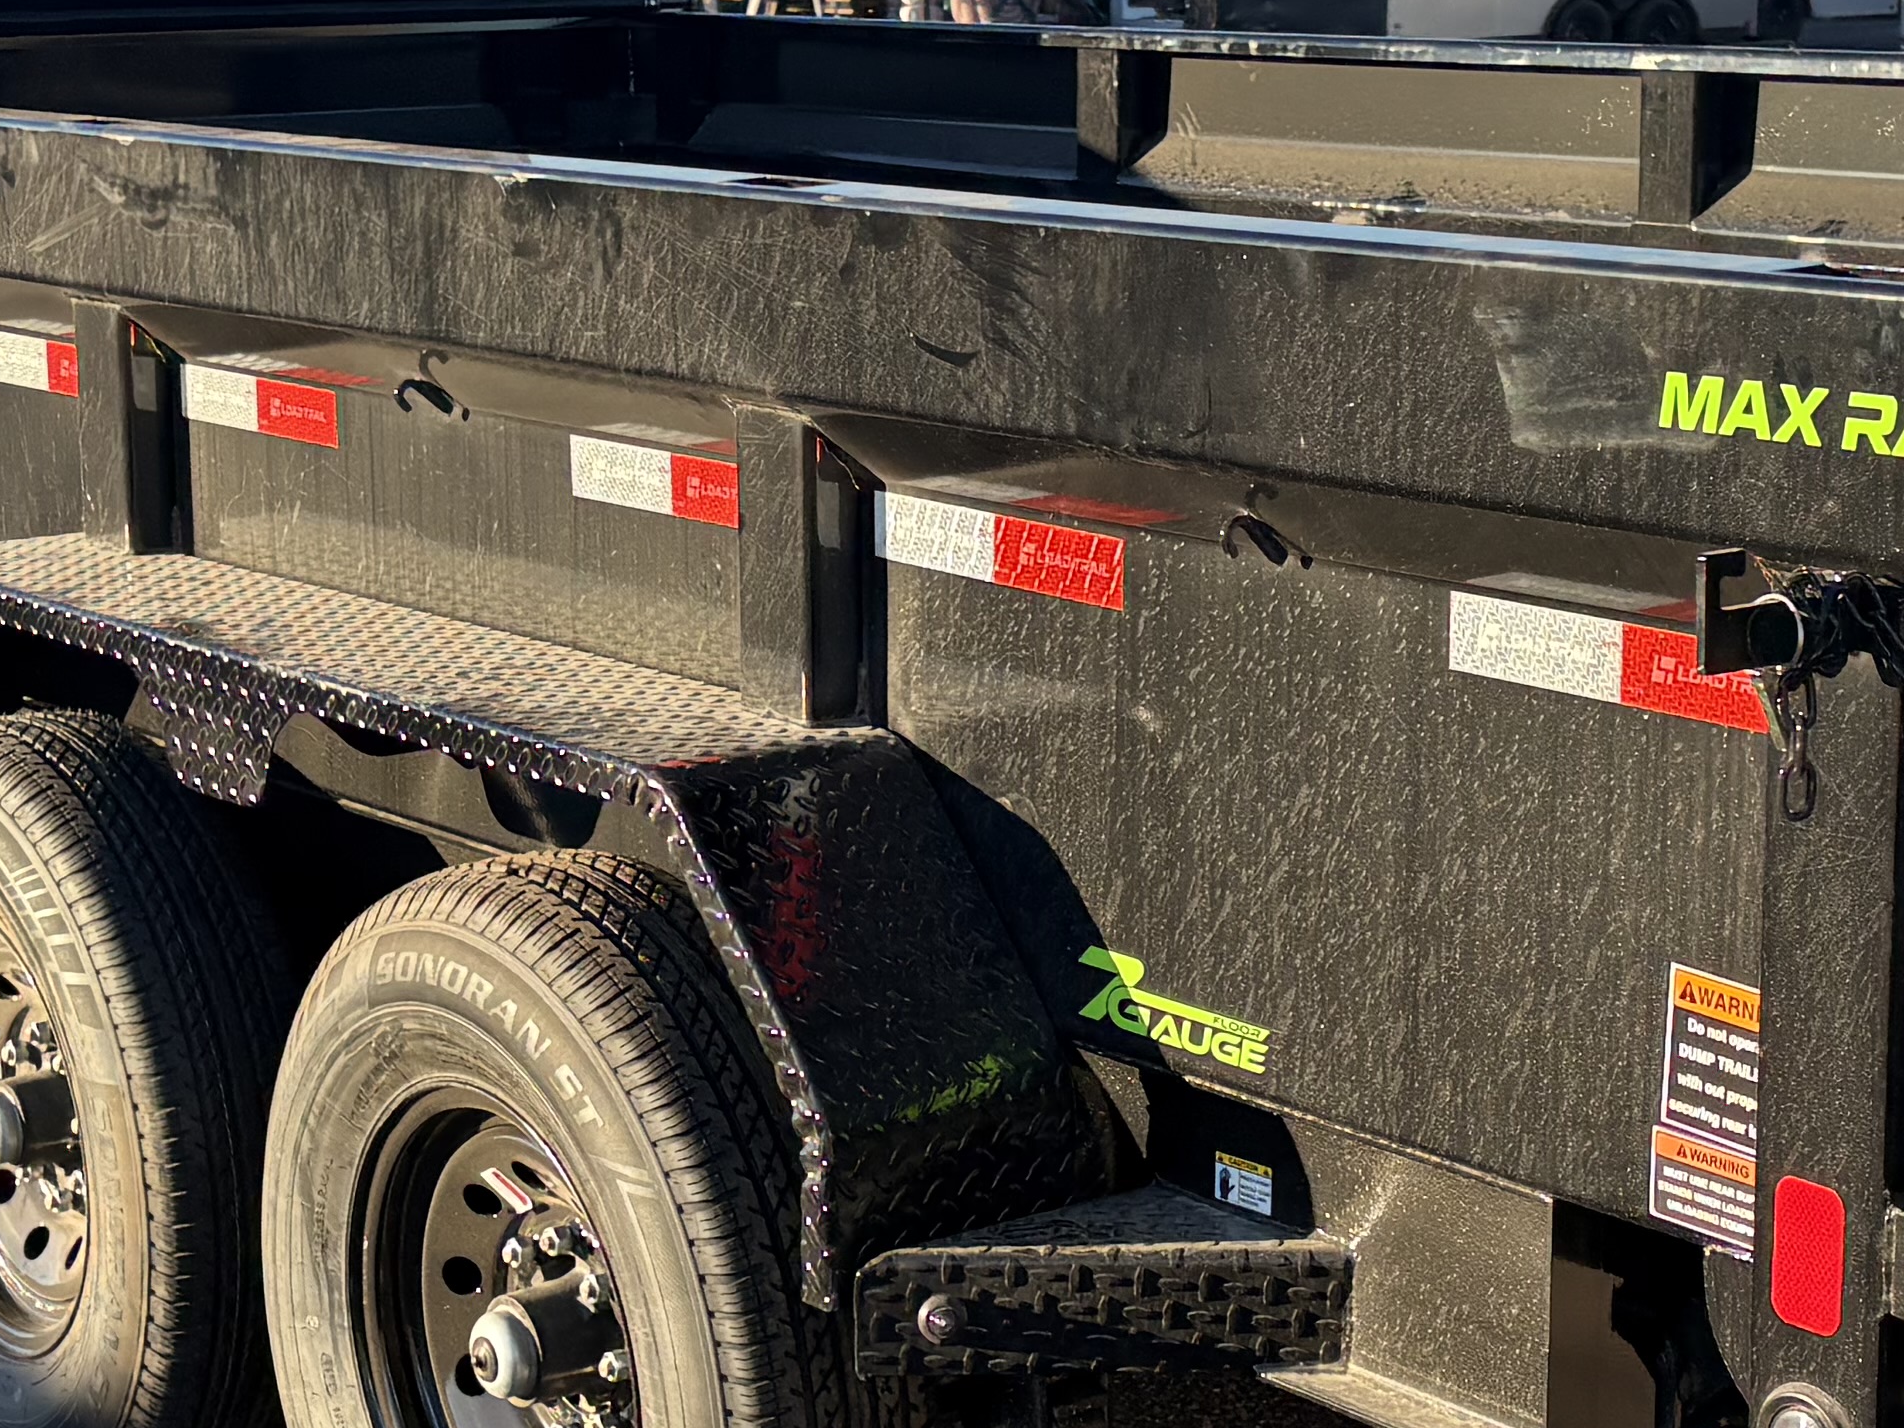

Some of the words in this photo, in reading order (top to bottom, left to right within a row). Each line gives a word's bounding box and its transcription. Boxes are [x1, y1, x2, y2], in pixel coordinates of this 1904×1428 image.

[1658, 371, 1830, 447] MAX
[375, 950, 552, 1061] SONORAN
[554, 1063, 605, 1129] ST
[1107, 986, 1270, 1074] GAUGE
[1213, 1016, 1262, 1039] FLOOR
[1687, 1016, 1705, 1035] Do
[1706, 1026, 1727, 1044] not
[1678, 1042, 1716, 1066] DUMP
[1677, 1072, 1703, 1092] with
[1704, 1081, 1725, 1099] out
[1668, 1097, 1721, 1129] securing
[1722, 1116, 1747, 1136] rear
[1689, 1147, 1750, 1179] WARNING
